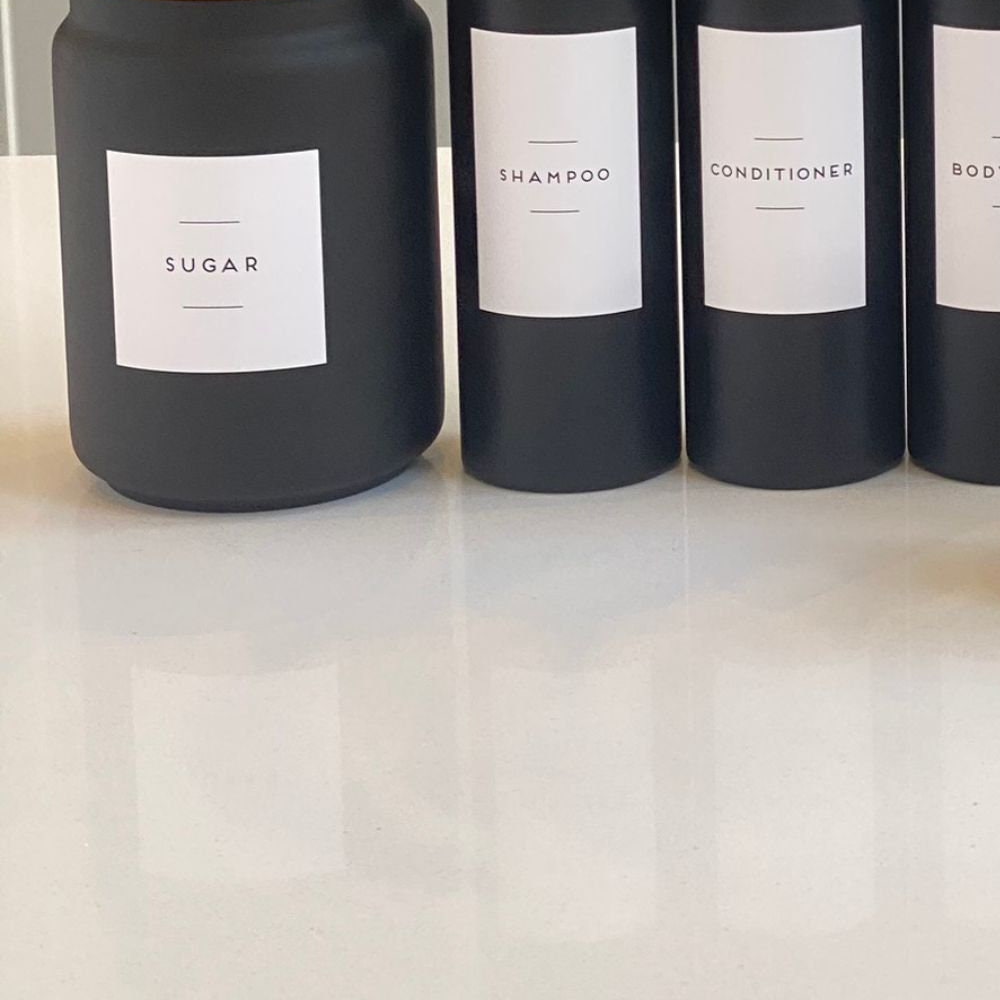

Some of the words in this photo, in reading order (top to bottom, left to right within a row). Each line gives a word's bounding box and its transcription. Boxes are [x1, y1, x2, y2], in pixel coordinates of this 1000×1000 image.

[499, 167, 611, 184] SHAMPOO
[710, 162, 854, 181] CONDITIONER
[164, 255, 259, 274] SUGAR
